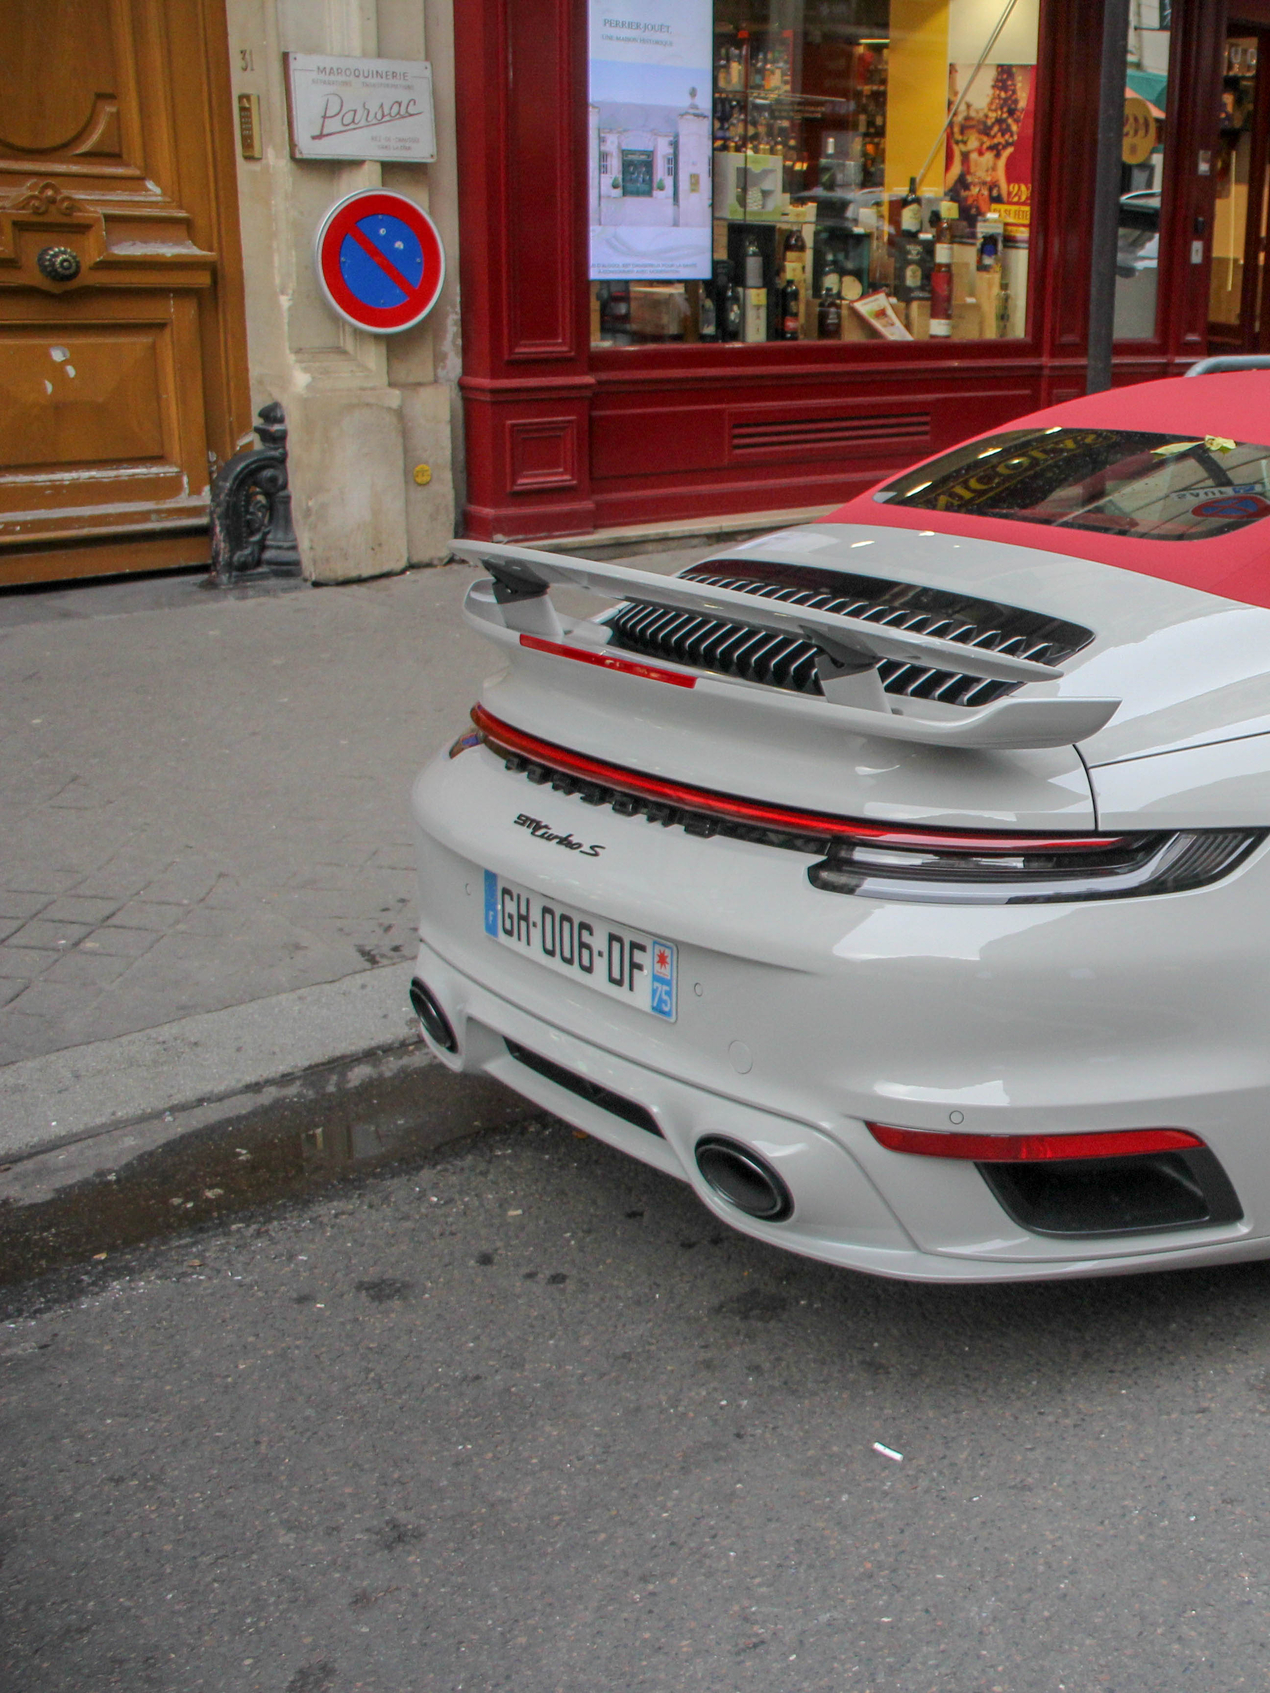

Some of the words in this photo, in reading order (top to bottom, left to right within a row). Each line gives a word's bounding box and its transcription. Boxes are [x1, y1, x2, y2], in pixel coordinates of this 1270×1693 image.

[240, 49, 255, 72] 31
[316, 65, 409, 81] MAROQUINERIE
[317, 92, 420, 138] Parsac
[579, 844, 606, 857] S
[501, 886, 647, 992] GH-006-DF
[653, 981, 671, 1011] 75
